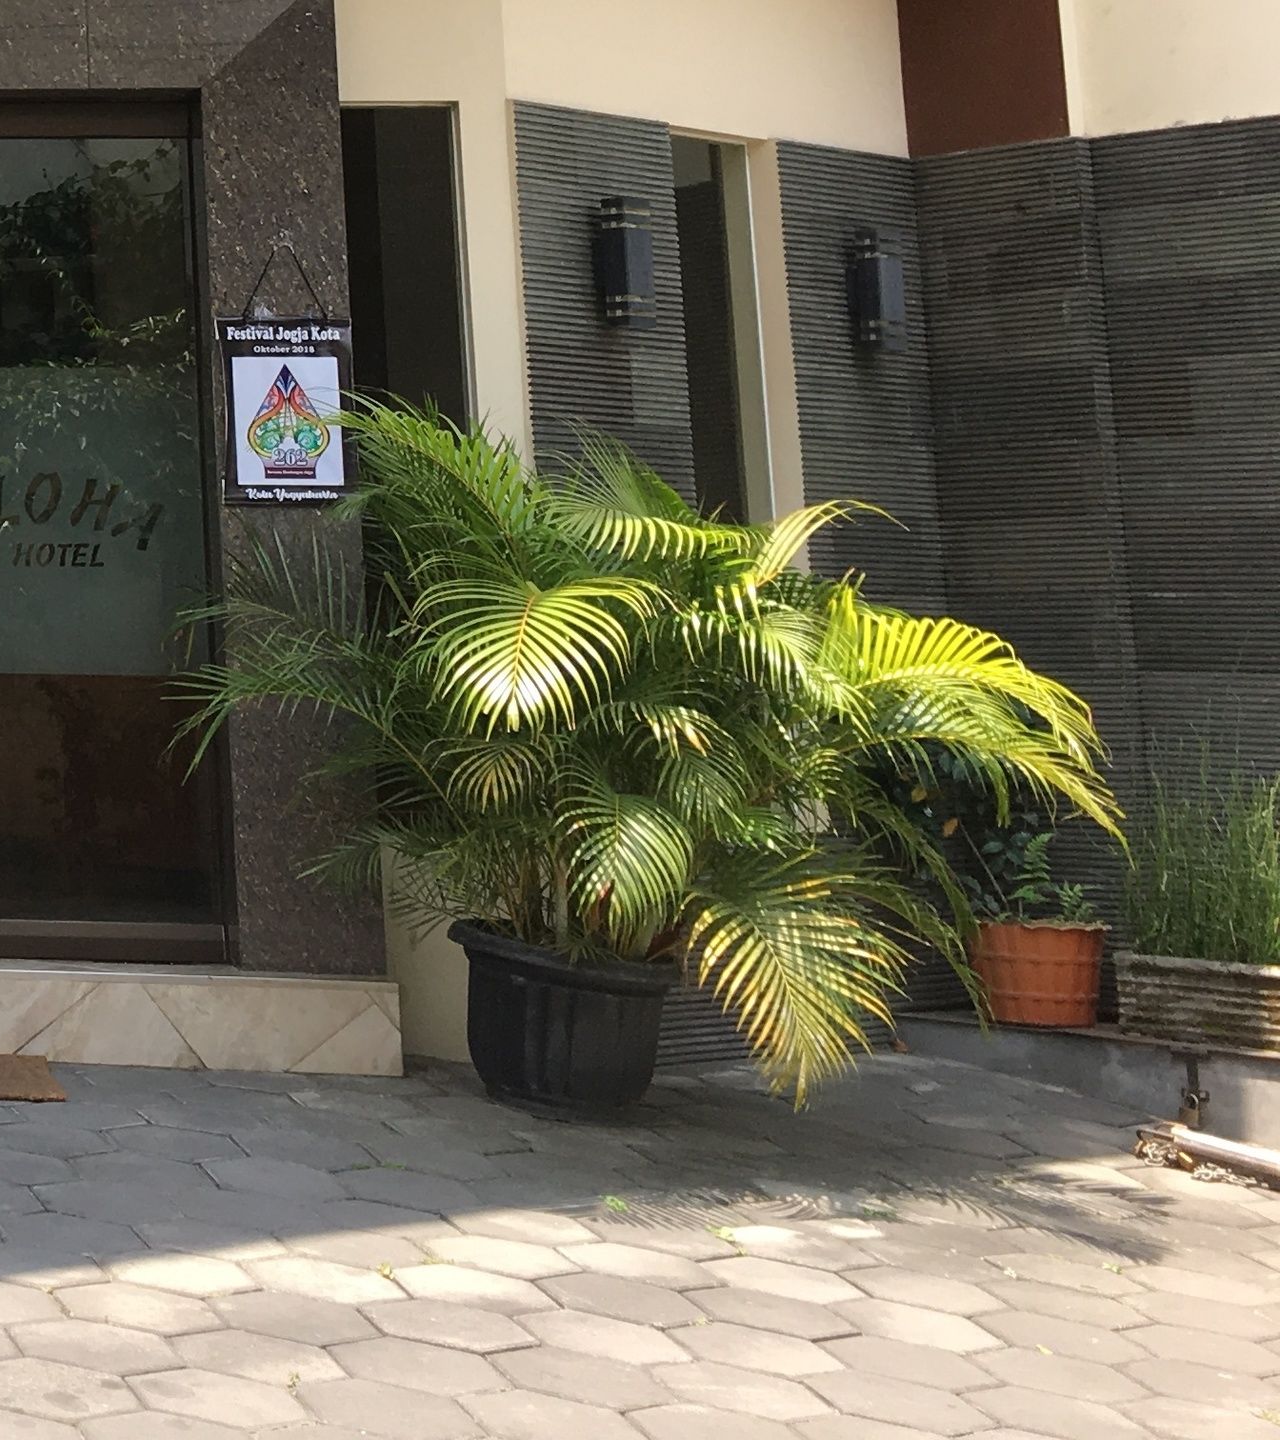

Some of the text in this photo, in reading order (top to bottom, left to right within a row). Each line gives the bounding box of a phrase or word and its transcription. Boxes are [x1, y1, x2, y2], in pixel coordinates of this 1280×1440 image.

[226, 326, 341, 343] Festival Jogja Kota
[253, 345, 315, 354] Oktober 2018
[274, 448, 308, 467] 262
[13, 542, 105, 568] HOTEL
